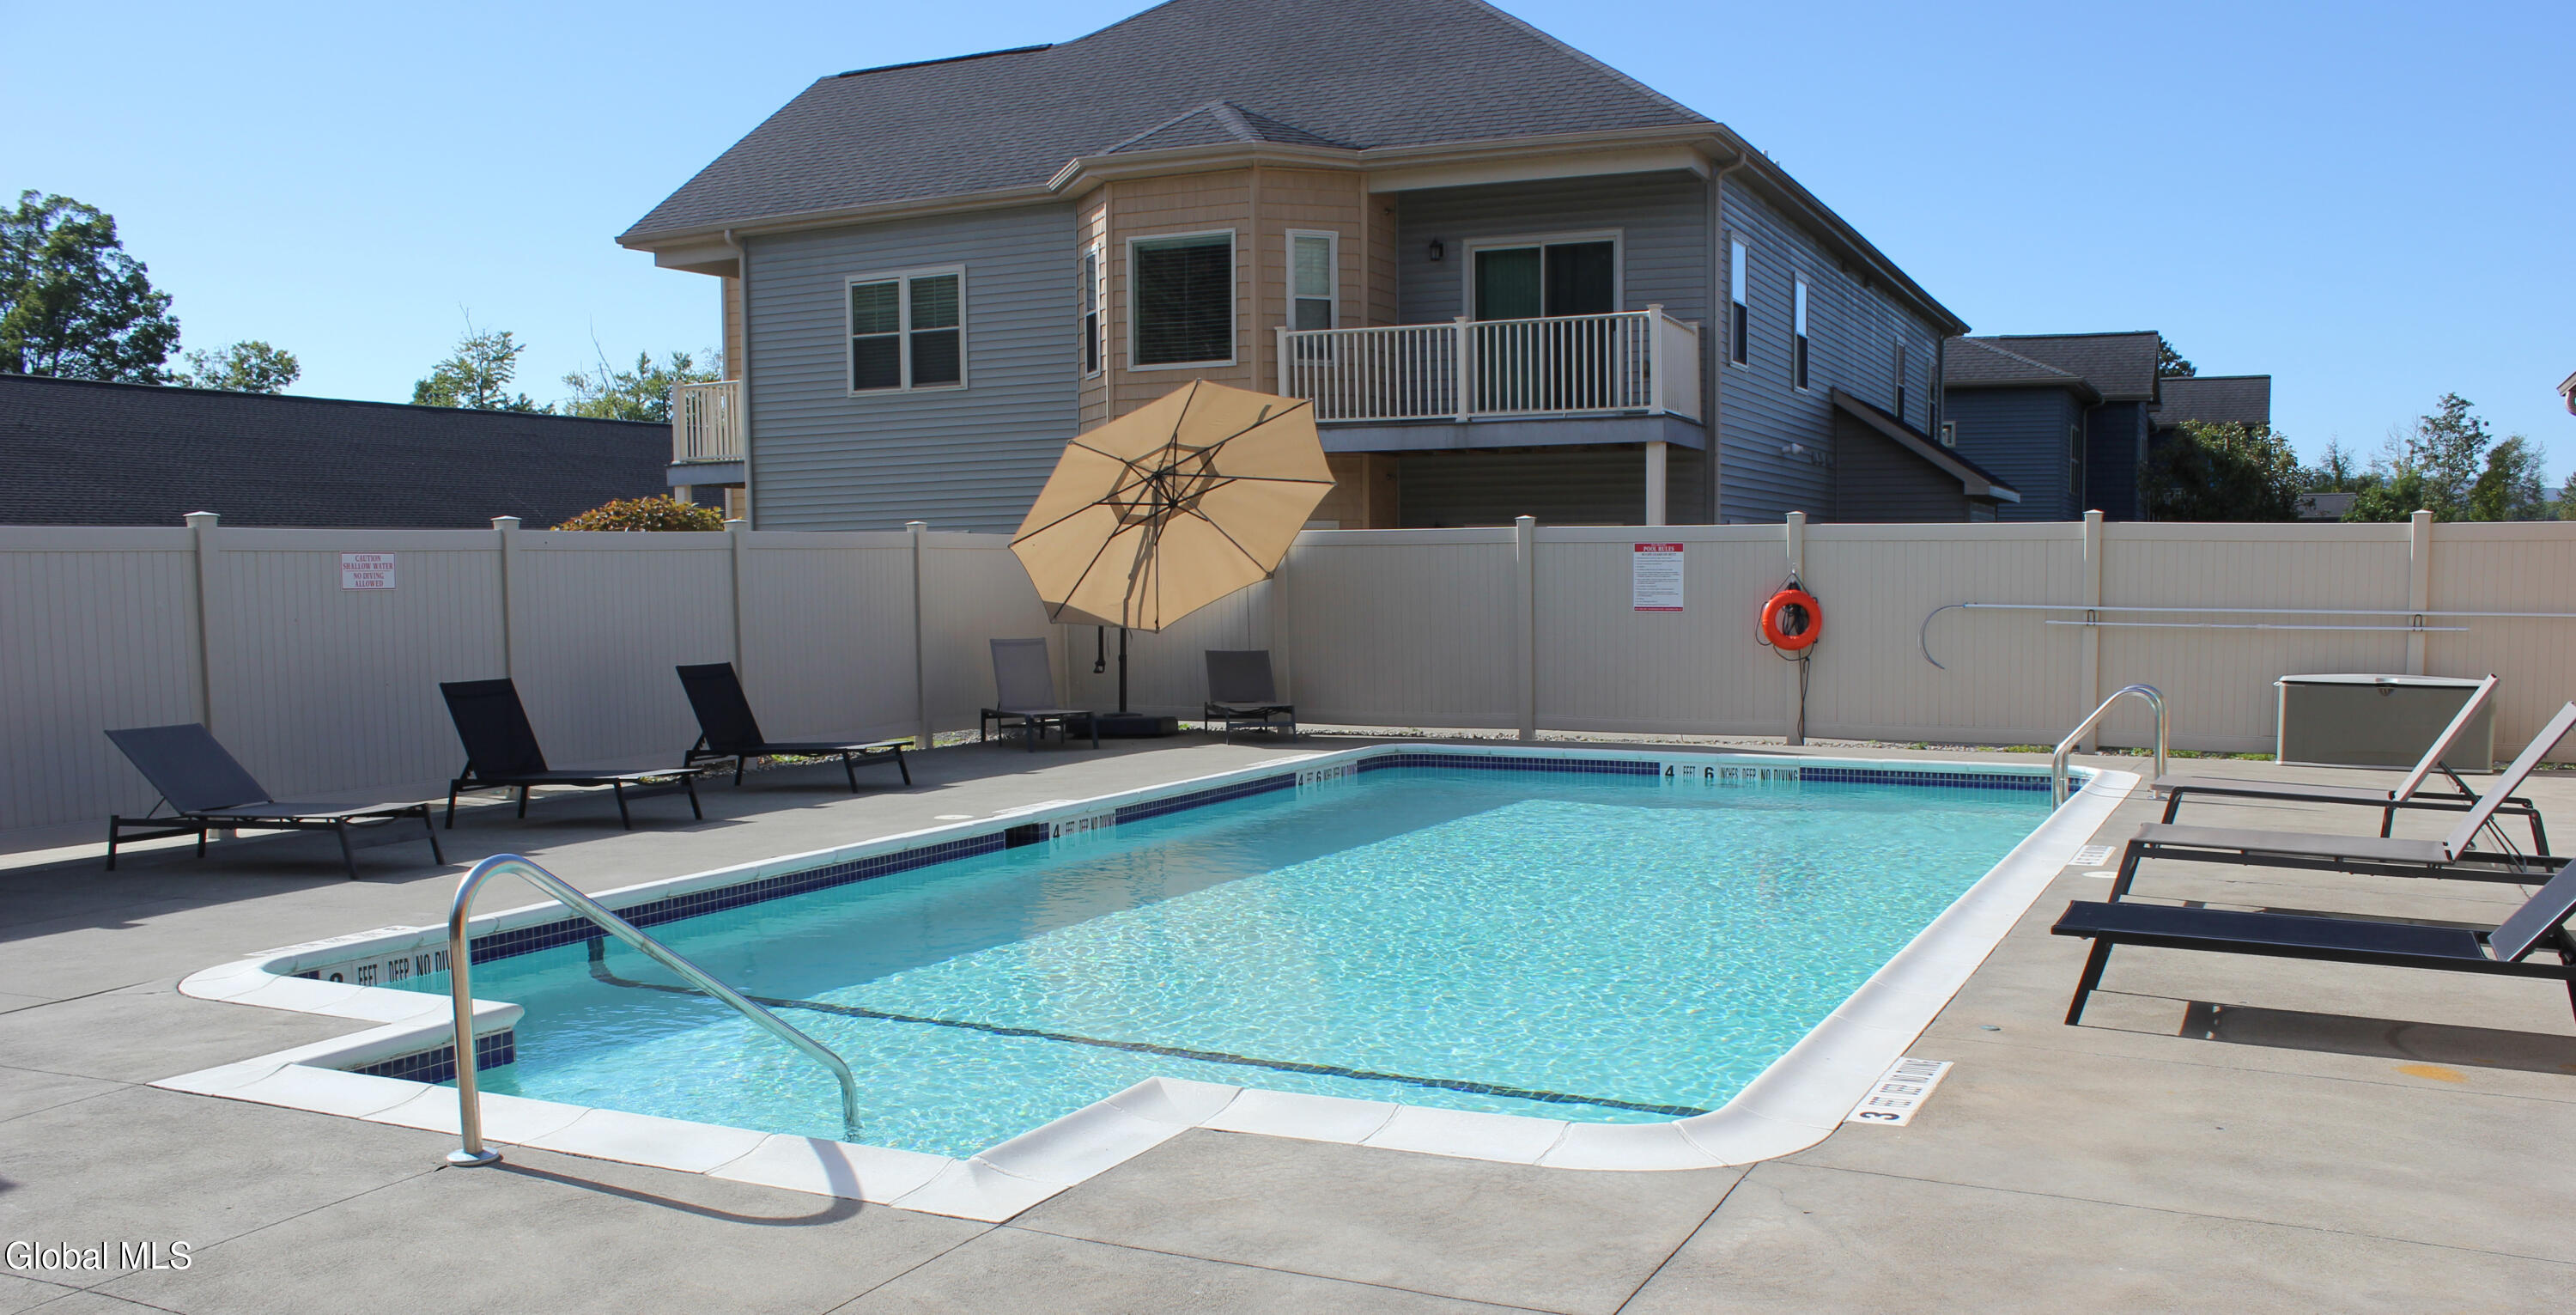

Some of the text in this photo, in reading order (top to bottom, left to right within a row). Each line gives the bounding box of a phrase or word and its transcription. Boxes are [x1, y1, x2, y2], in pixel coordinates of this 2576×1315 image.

[1298, 774, 1303, 786] 4
[1316, 770, 1321, 782] 6
[1665, 764, 1674, 776] 4
[1704, 766, 1714, 778] 6
[1760, 769, 1771, 781] NO
[1774, 769, 1798, 782] DIVING
[1053, 824, 1060, 838] 4
[1091, 816, 1097, 830] NO
[1100, 813, 1115, 828] DIVING
[416, 953, 430, 977] NO
[1868, 1096, 1913, 1108] FEET
[1859, 1111, 1900, 1121] 3
